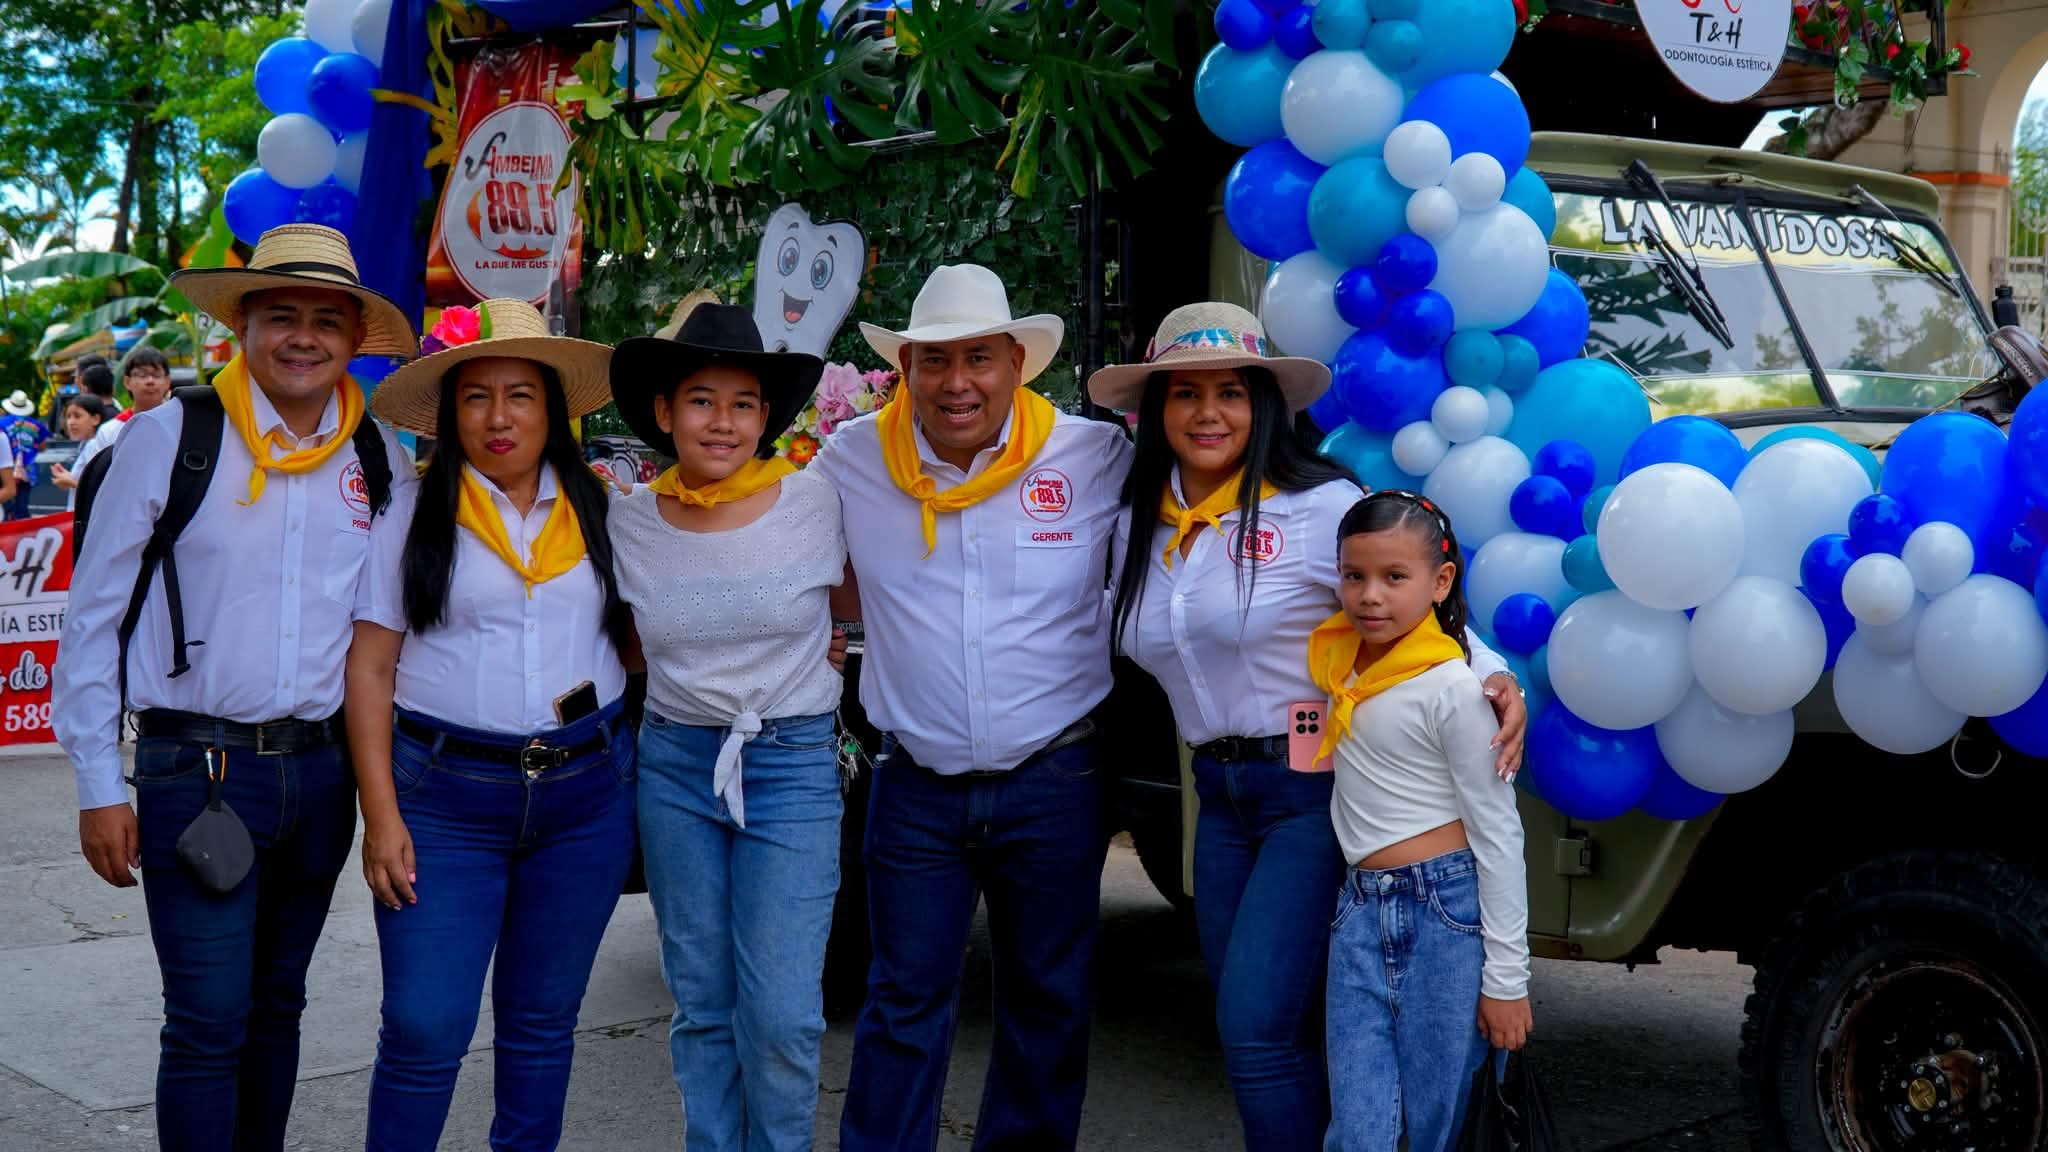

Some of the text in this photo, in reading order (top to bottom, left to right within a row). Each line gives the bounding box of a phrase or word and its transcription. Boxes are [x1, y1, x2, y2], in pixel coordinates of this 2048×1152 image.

[1664, 48, 1773, 72] ODONTOLOGÍA ESTÉTICA
[485, 180, 557, 236] 89.5
[1601, 201, 1898, 260] LA VANIDOSA
[475, 259, 490, 269] LA
[491, 259, 510, 269] QUE
[511, 259, 527, 269] ME
[1031, 532, 1073, 541] GERENTE
[9, 649, 49, 690] de
